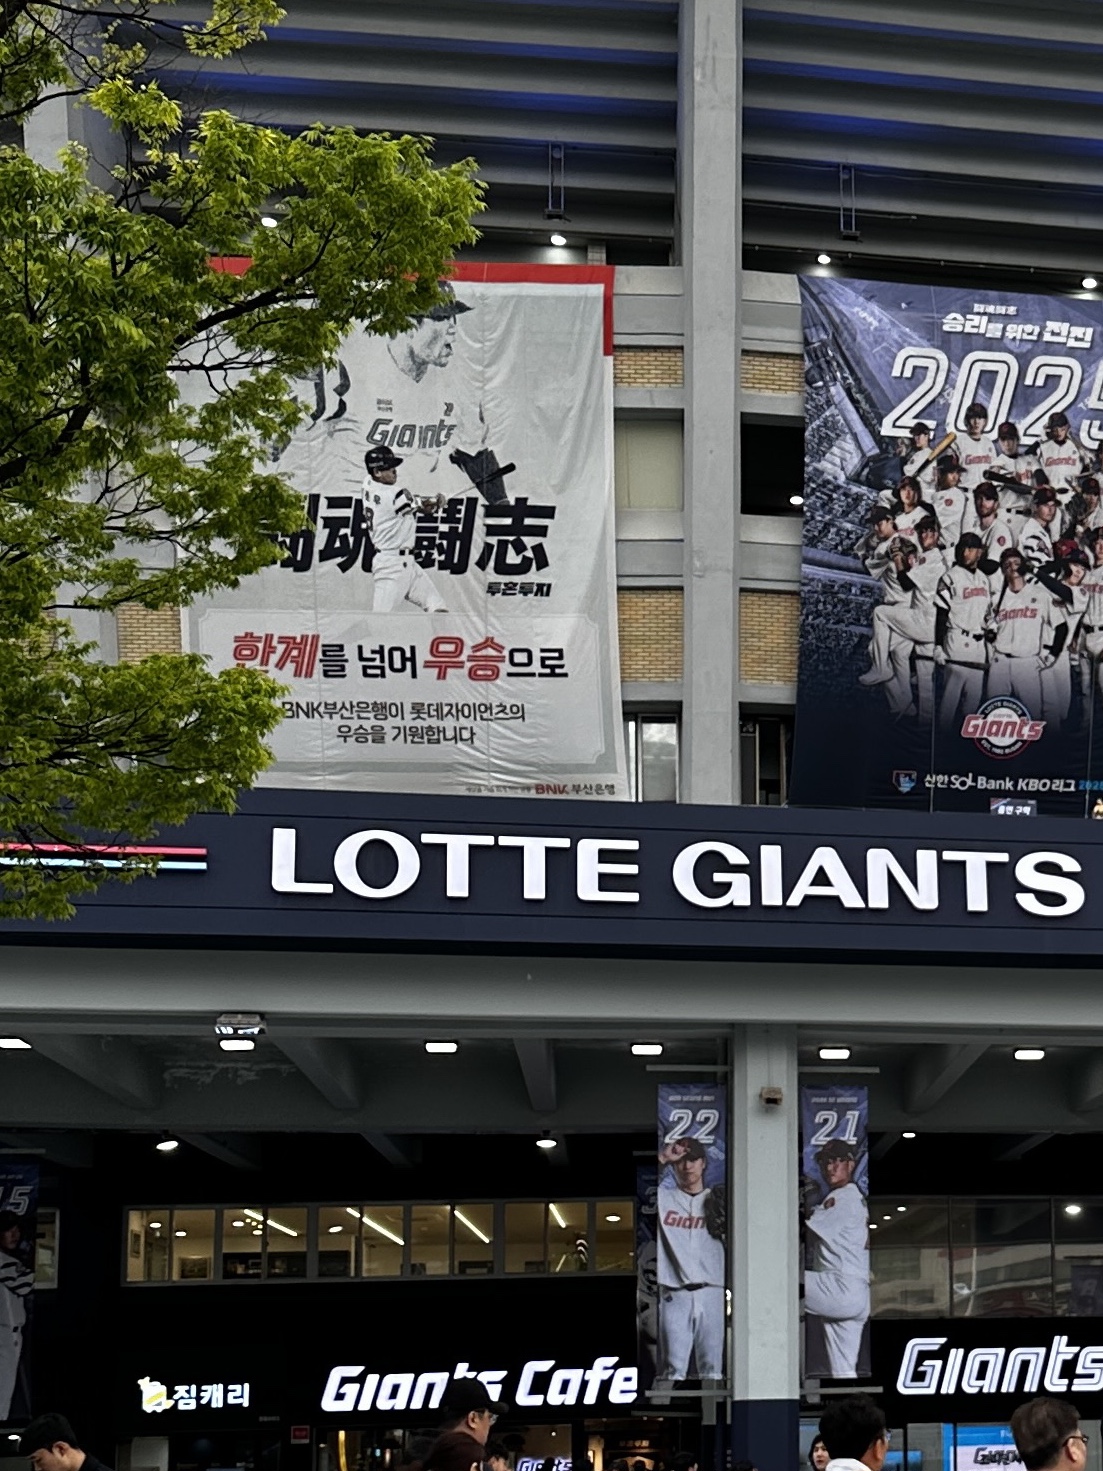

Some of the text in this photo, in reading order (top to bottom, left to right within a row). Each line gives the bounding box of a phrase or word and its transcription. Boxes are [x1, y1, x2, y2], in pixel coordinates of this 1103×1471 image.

[942, 312, 1094, 348] 승리를 위한 전진
[233, 632, 568, 682] 한계를 넘어 우승으로
[283, 701, 525, 723] BNK부산은행이 롯데자이언츠의
[336, 724, 476, 746] 우승을 기원합니다
[961, 714, 1047, 741] Giants
[924, 773, 949, 789] 신한
[976, 775, 1014, 791] Bank
[1016, 778, 1050, 792] KBO
[1051, 778, 1076, 793] 리그
[271, 827, 1087, 918] LOTTE GIANTS
[665, 1109, 720, 1144] 22
[811, 1110, 860, 1145] 21
[0, 1186, 34, 1216] 5
[641, 1186, 658, 1214] 3
[172, 1381, 250, 1410] 짐캐리
[515, 1356, 639, 1407] Cafe
